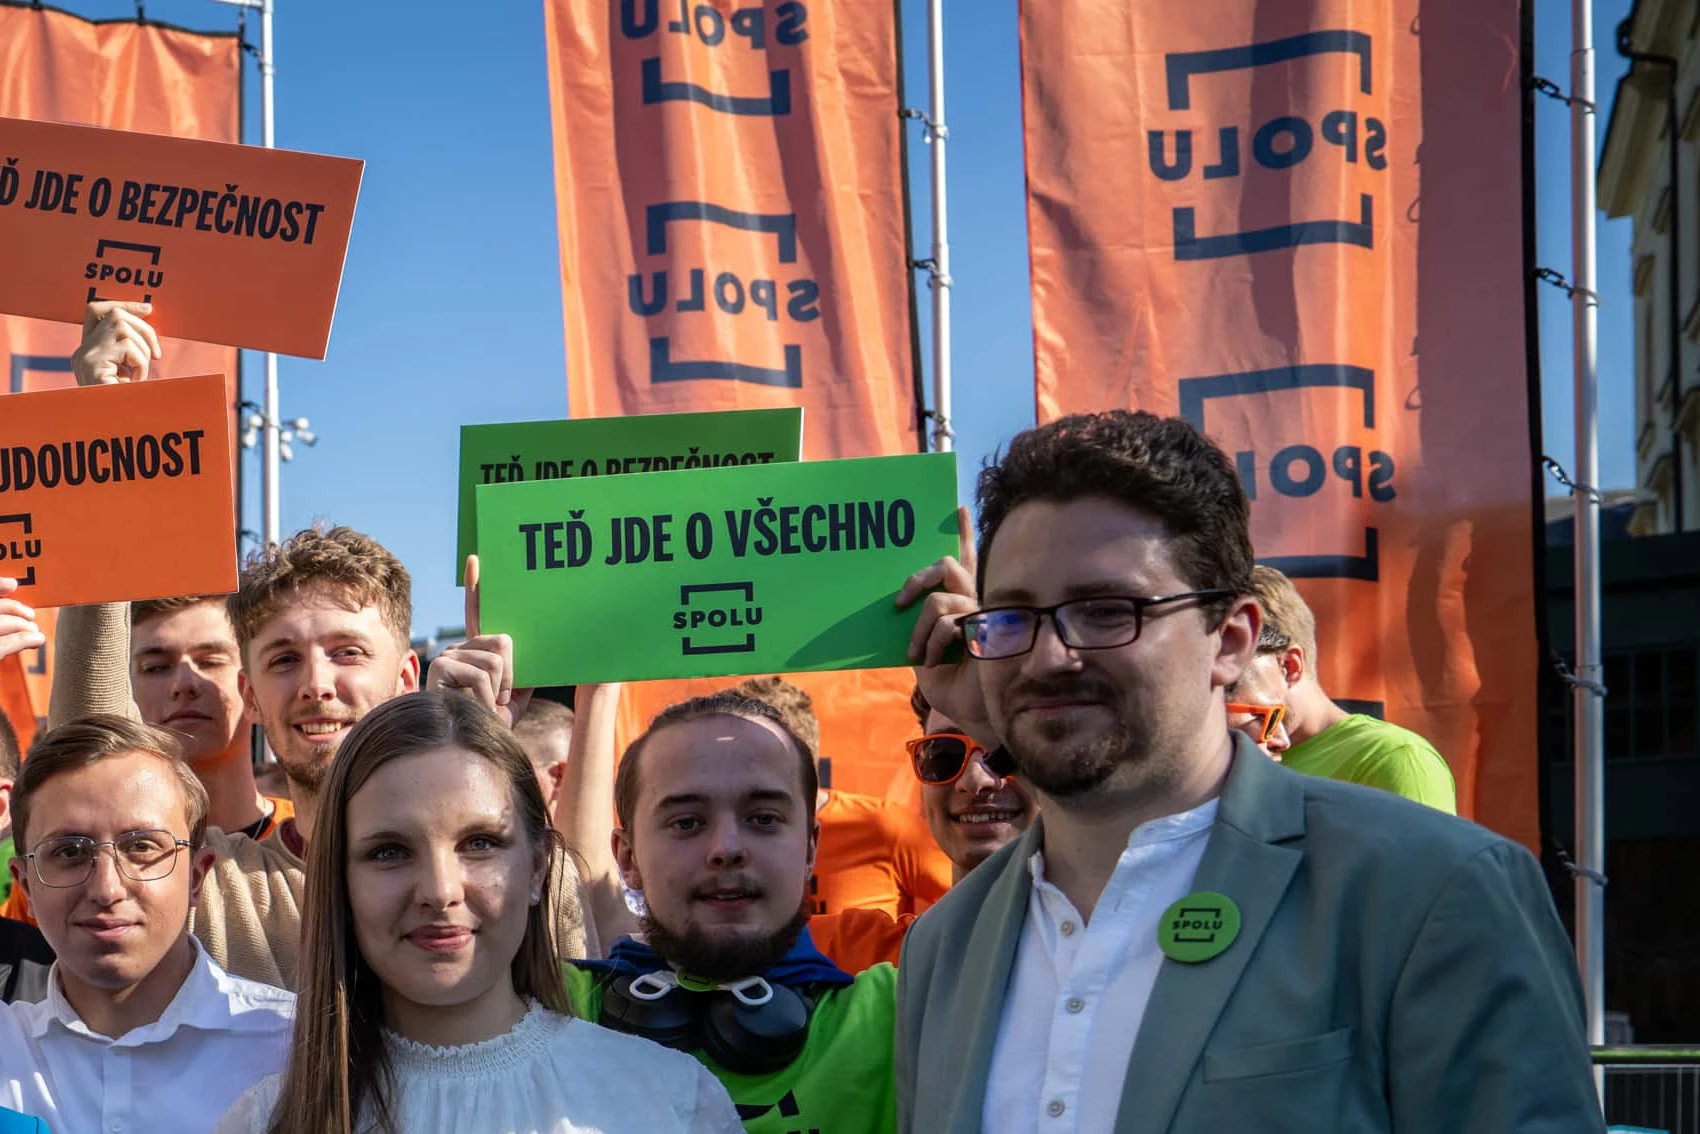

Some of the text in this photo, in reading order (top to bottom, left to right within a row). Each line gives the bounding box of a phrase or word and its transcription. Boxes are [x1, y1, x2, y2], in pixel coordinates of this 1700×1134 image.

[24, 170, 83, 214] JDE
[89, 178, 111, 217] O
[118, 181, 324, 244] BEZPEČNOST
[84, 263, 163, 287] SPOLU
[519, 497, 915, 570] TEĎ JDE O VŠECHNO
[674, 608, 762, 629] SPOLU
[1172, 920, 1223, 930] SPOLU
